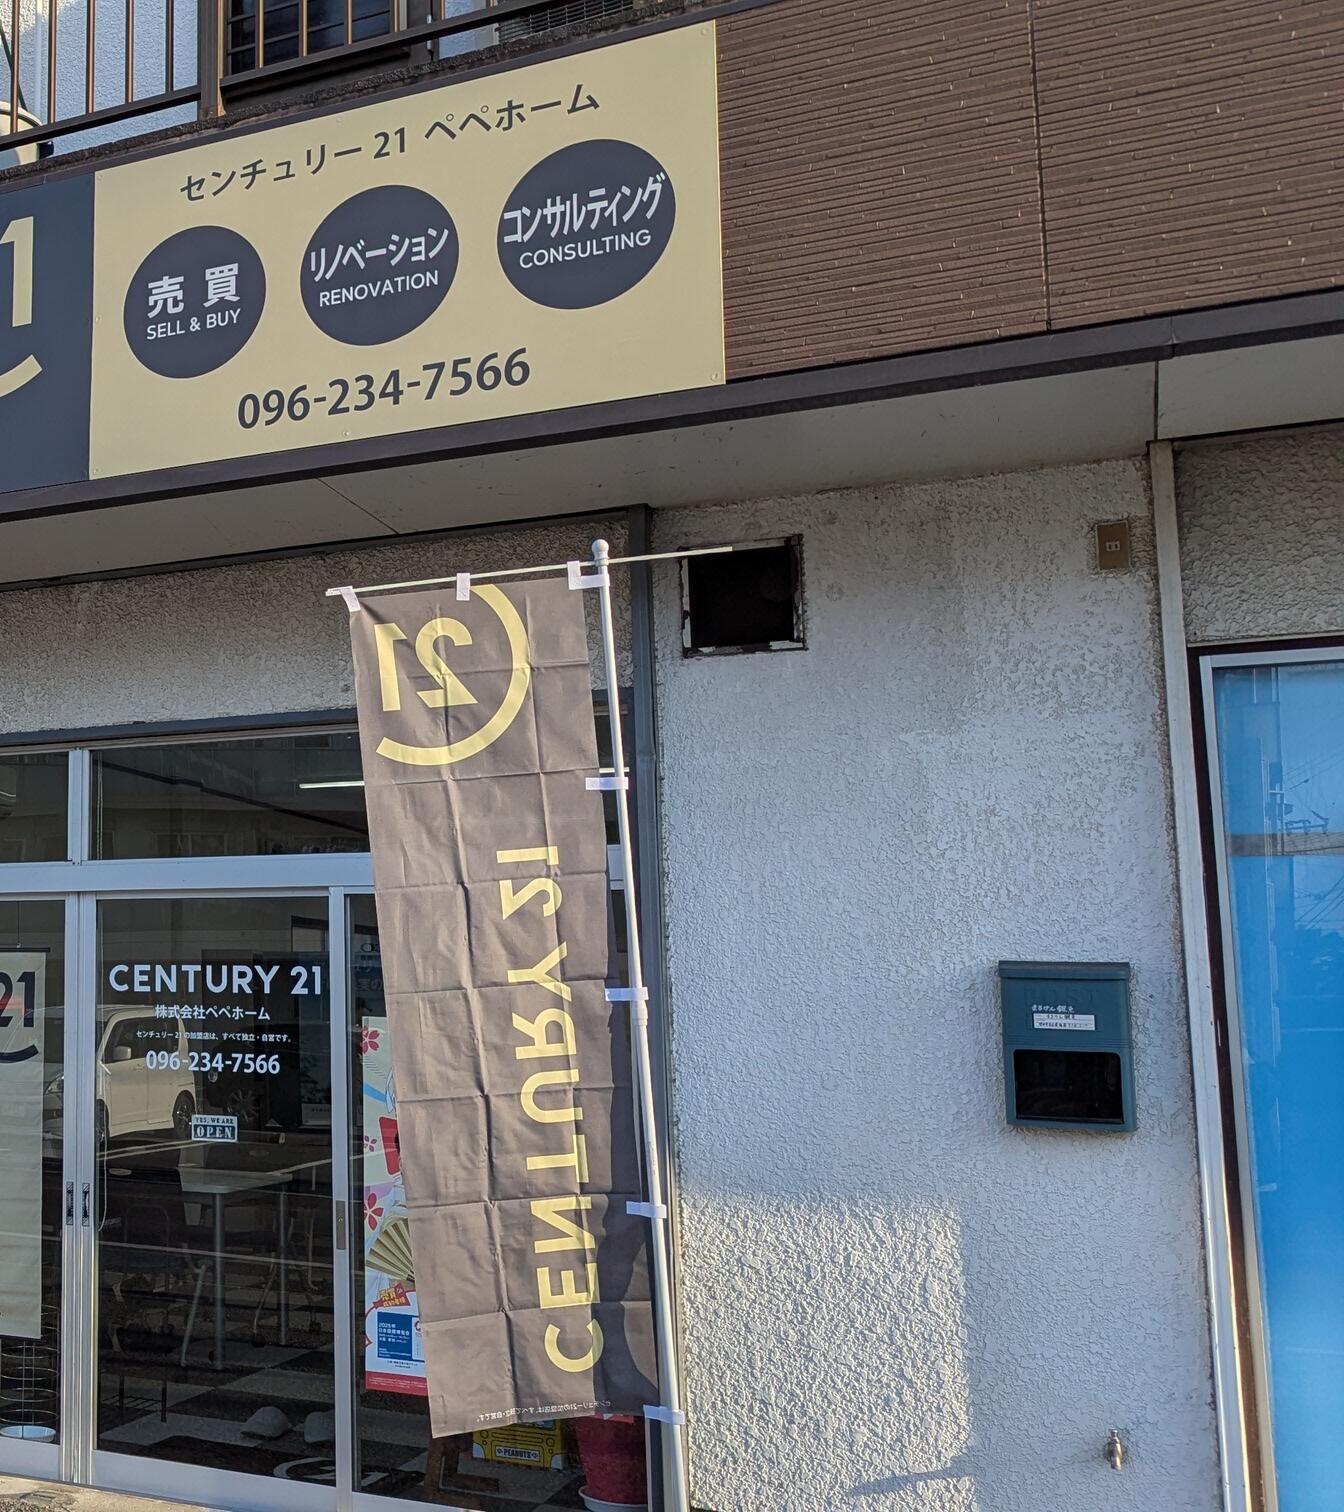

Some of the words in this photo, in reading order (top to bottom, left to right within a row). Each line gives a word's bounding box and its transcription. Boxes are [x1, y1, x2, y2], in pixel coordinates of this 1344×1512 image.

[180, 144, 362, 202] センチュリー
[373, 127, 407, 159] 21
[424, 83, 600, 143] ペペホーム
[503, 172, 667, 245] コンサルティング
[309, 226, 450, 283] リノベーション
[518, 229, 653, 269] CONSULTING
[319, 270, 439, 307] RENOVATION
[146, 319, 185, 340] SELL
[190, 316, 201, 332] &
[206, 308, 241, 328] BUY
[237, 347, 530, 429] 096-234-7566
[109, 964, 280, 994] CENTURY
[290, 965, 321, 995] 21
[146, 1050, 281, 1075] 096-234-7566
[196, 1126, 233, 1138] OPEN
